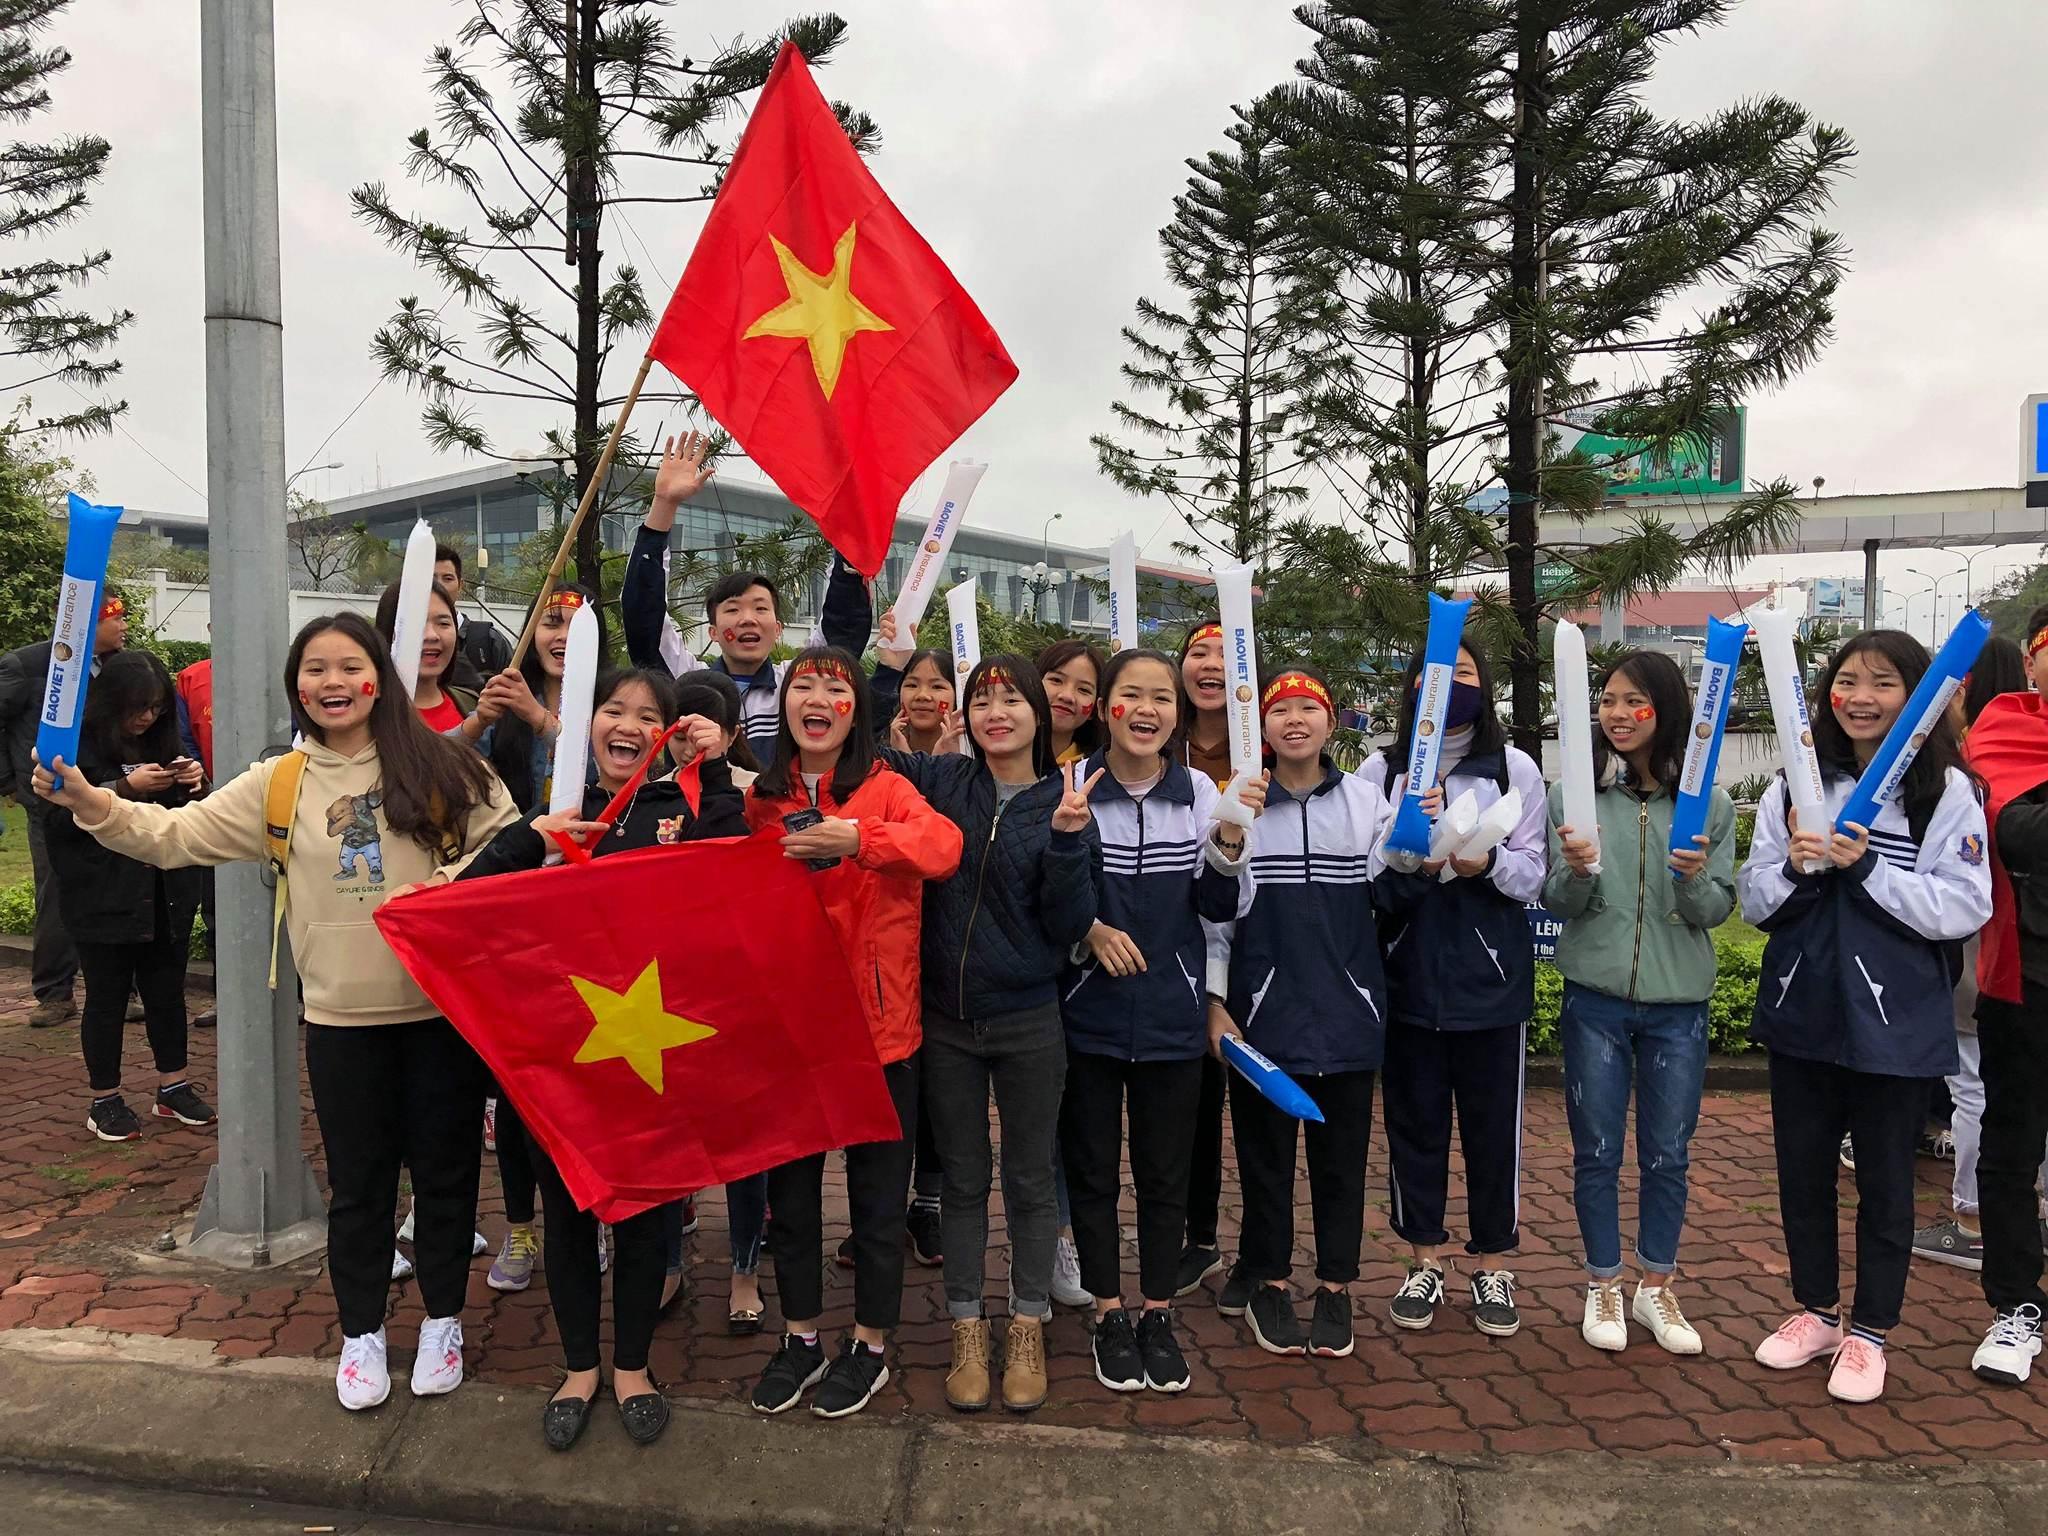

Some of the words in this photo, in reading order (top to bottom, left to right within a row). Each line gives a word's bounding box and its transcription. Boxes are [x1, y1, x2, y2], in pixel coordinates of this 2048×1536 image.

[933, 501, 955, 539] BAOVIET
[911, 553, 933, 592] Insurance
[1541, 579, 1557, 588] open
[46, 663, 64, 722] BAOVIET
[59, 582, 78, 640] Insurance
[955, 623, 966, 659] BAOVIET
[1235, 628, 1248, 681] BAOVIET
[1702, 667, 1723, 720] BAOVIET
[1240, 705, 1252, 759] Insurance
[1411, 739, 1428, 791] BAOVIET
[1424, 667, 1441, 718] Insurance
[1792, 675, 1809, 726] BAOVIET
[1807, 750, 1822, 801] Insurance
[1880, 751, 1914, 801] BAOVIET
[1923, 683, 1958, 732] Insurance
[1685, 741, 1705, 791] Insurance
[1535, 919, 1563, 937] LÊN
[1540, 944, 1555, 955] the
